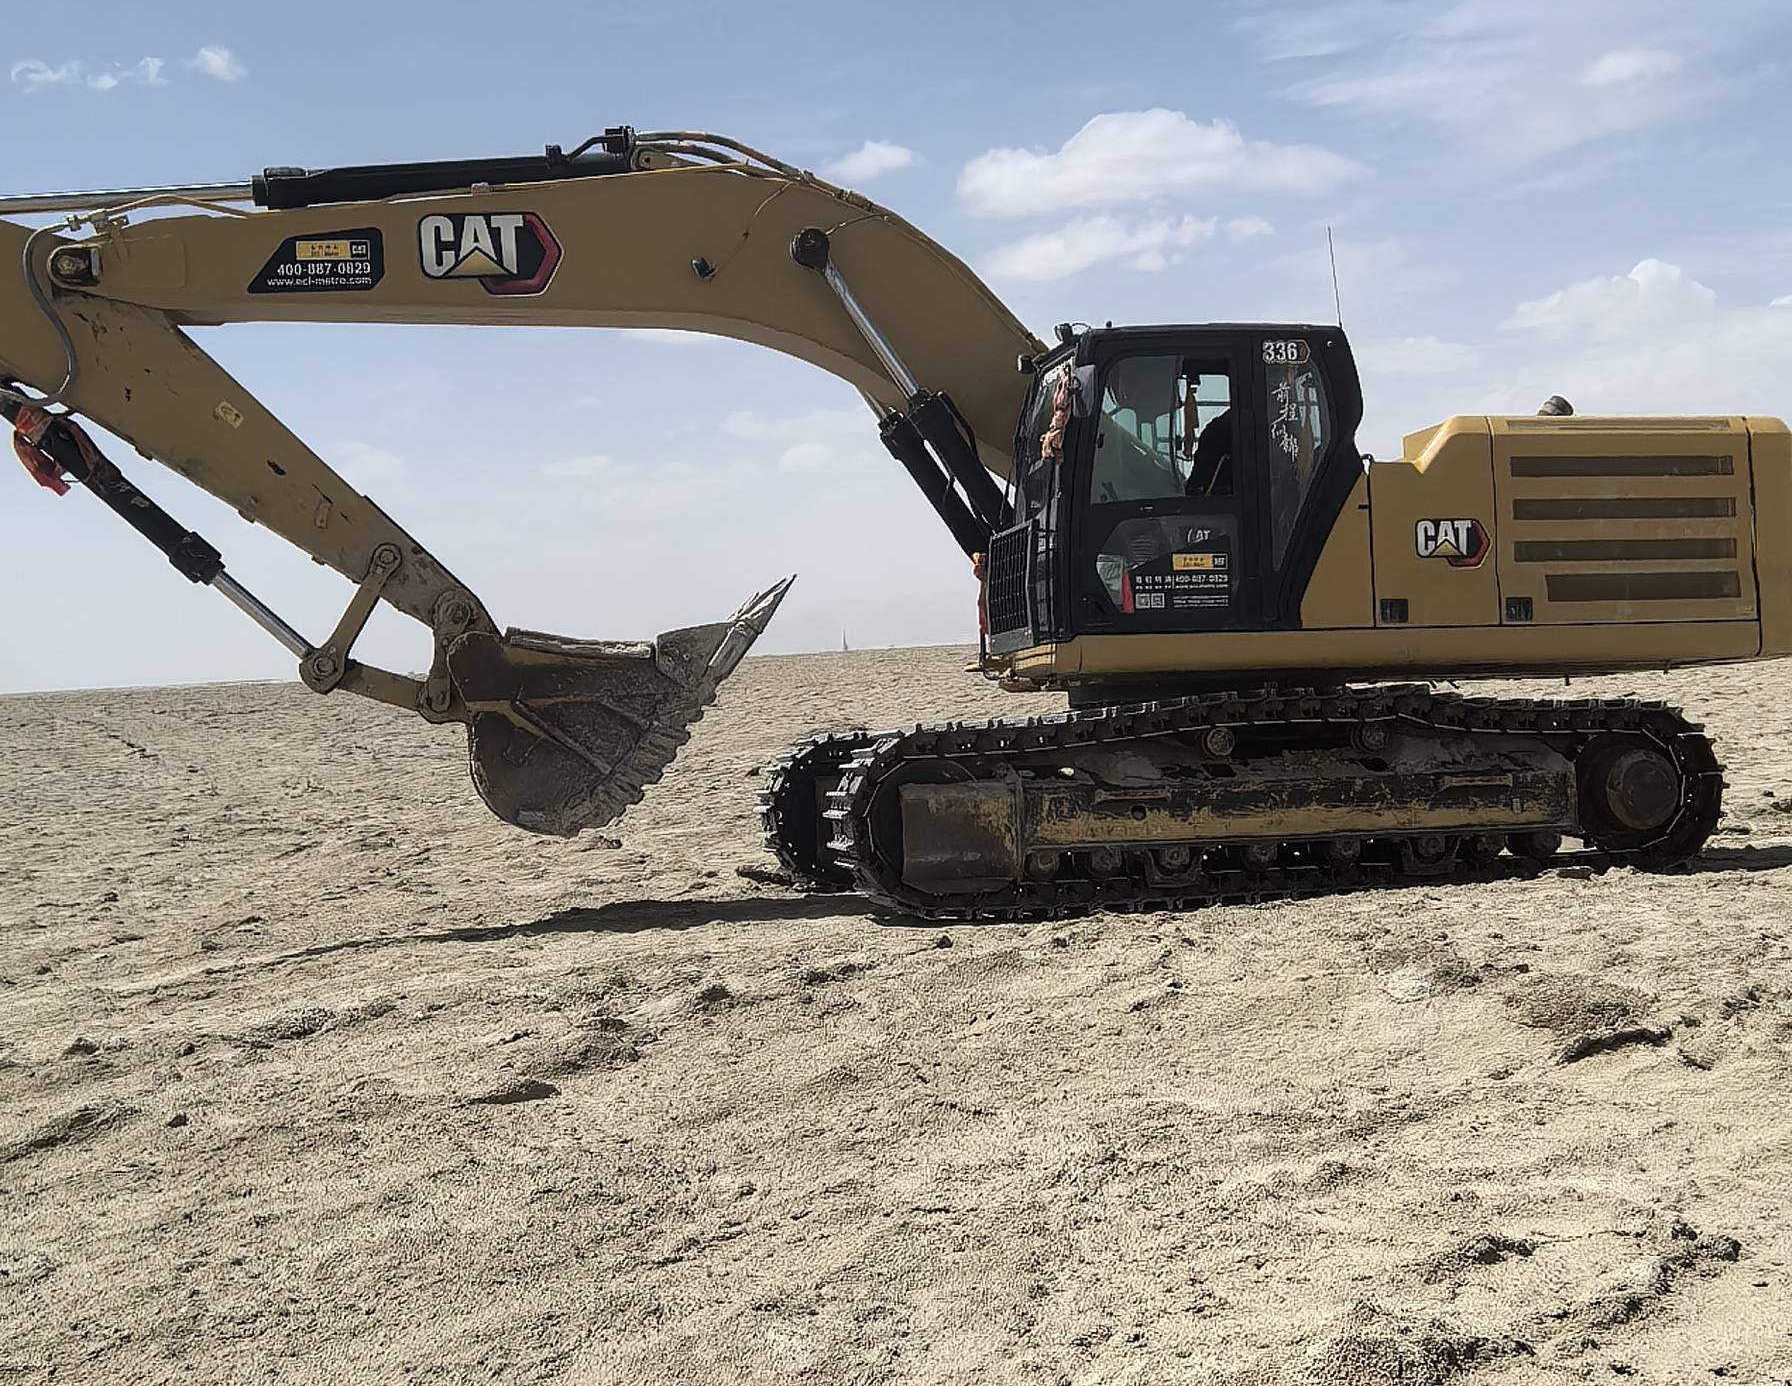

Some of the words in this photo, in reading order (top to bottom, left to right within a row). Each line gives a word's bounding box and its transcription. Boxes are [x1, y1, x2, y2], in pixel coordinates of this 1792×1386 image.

[420, 215, 524, 277] CAT
[1265, 342, 1298, 361] 336
[1417, 520, 1472, 556] CAT
